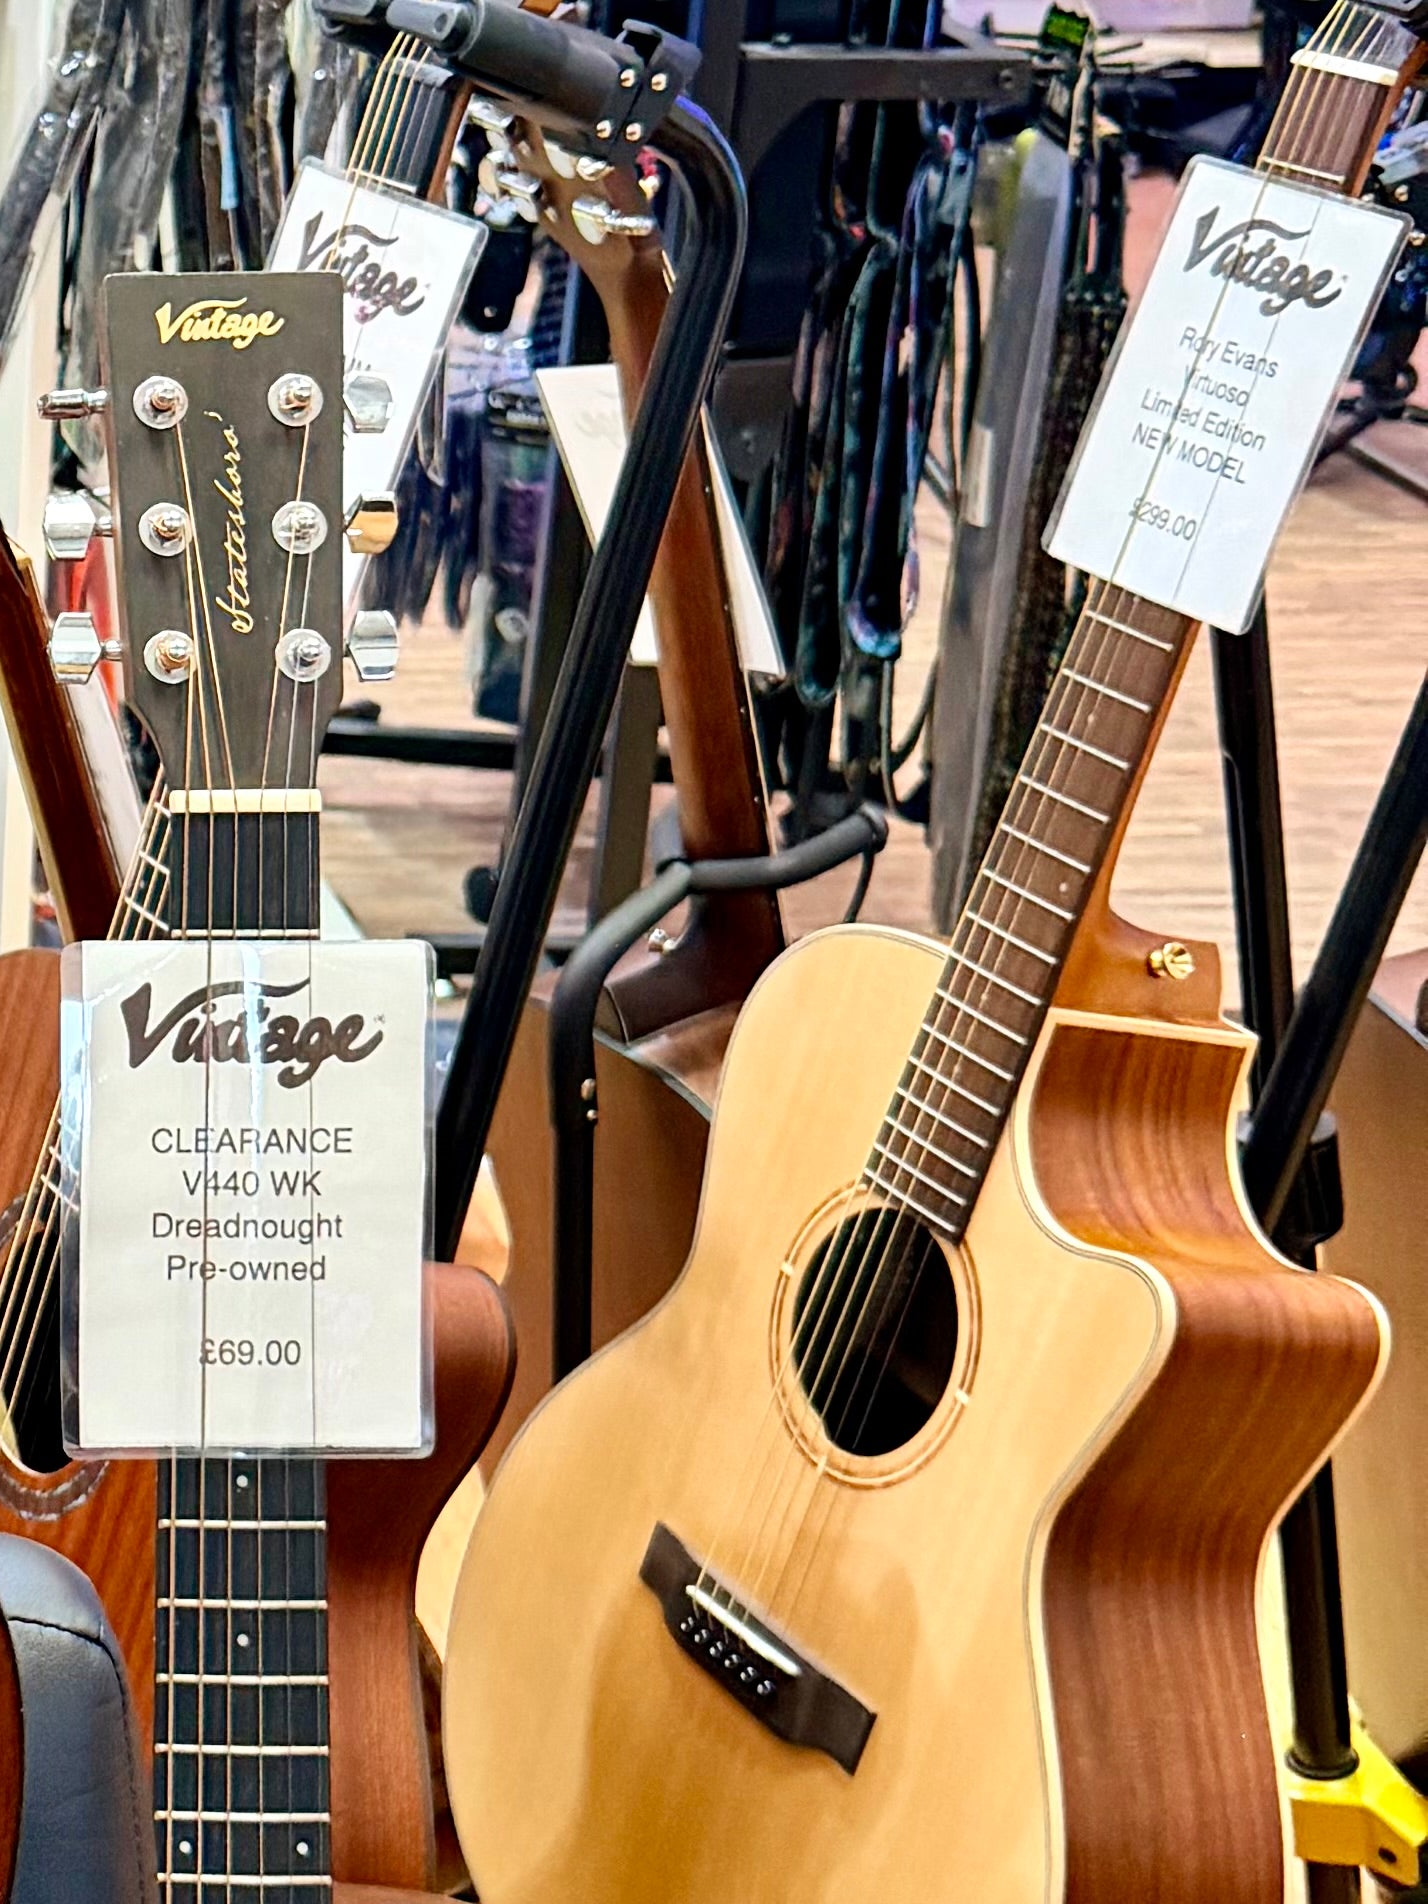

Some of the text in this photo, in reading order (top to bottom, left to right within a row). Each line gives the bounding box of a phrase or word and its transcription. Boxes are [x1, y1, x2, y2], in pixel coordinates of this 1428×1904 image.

[1182, 205, 1343, 317] Vintage
[154, 296, 286, 350] Vintage
[1179, 326, 1279, 379] Rory Evans
[1184, 363, 1251, 408] Virtuoso
[1132, 421, 1247, 485] NEW MODEL
[1201, 411, 1267, 452] Edition
[120, 976, 384, 1090] Vintage
[151, 1127, 354, 1155] CLEARANCE
[181, 1170, 322, 1197] V440 WK
[151, 1211, 344, 1245] Dreadnought
[167, 1254, 327, 1281] Pre-owned
[198, 1338, 302, 1366] £69.00
